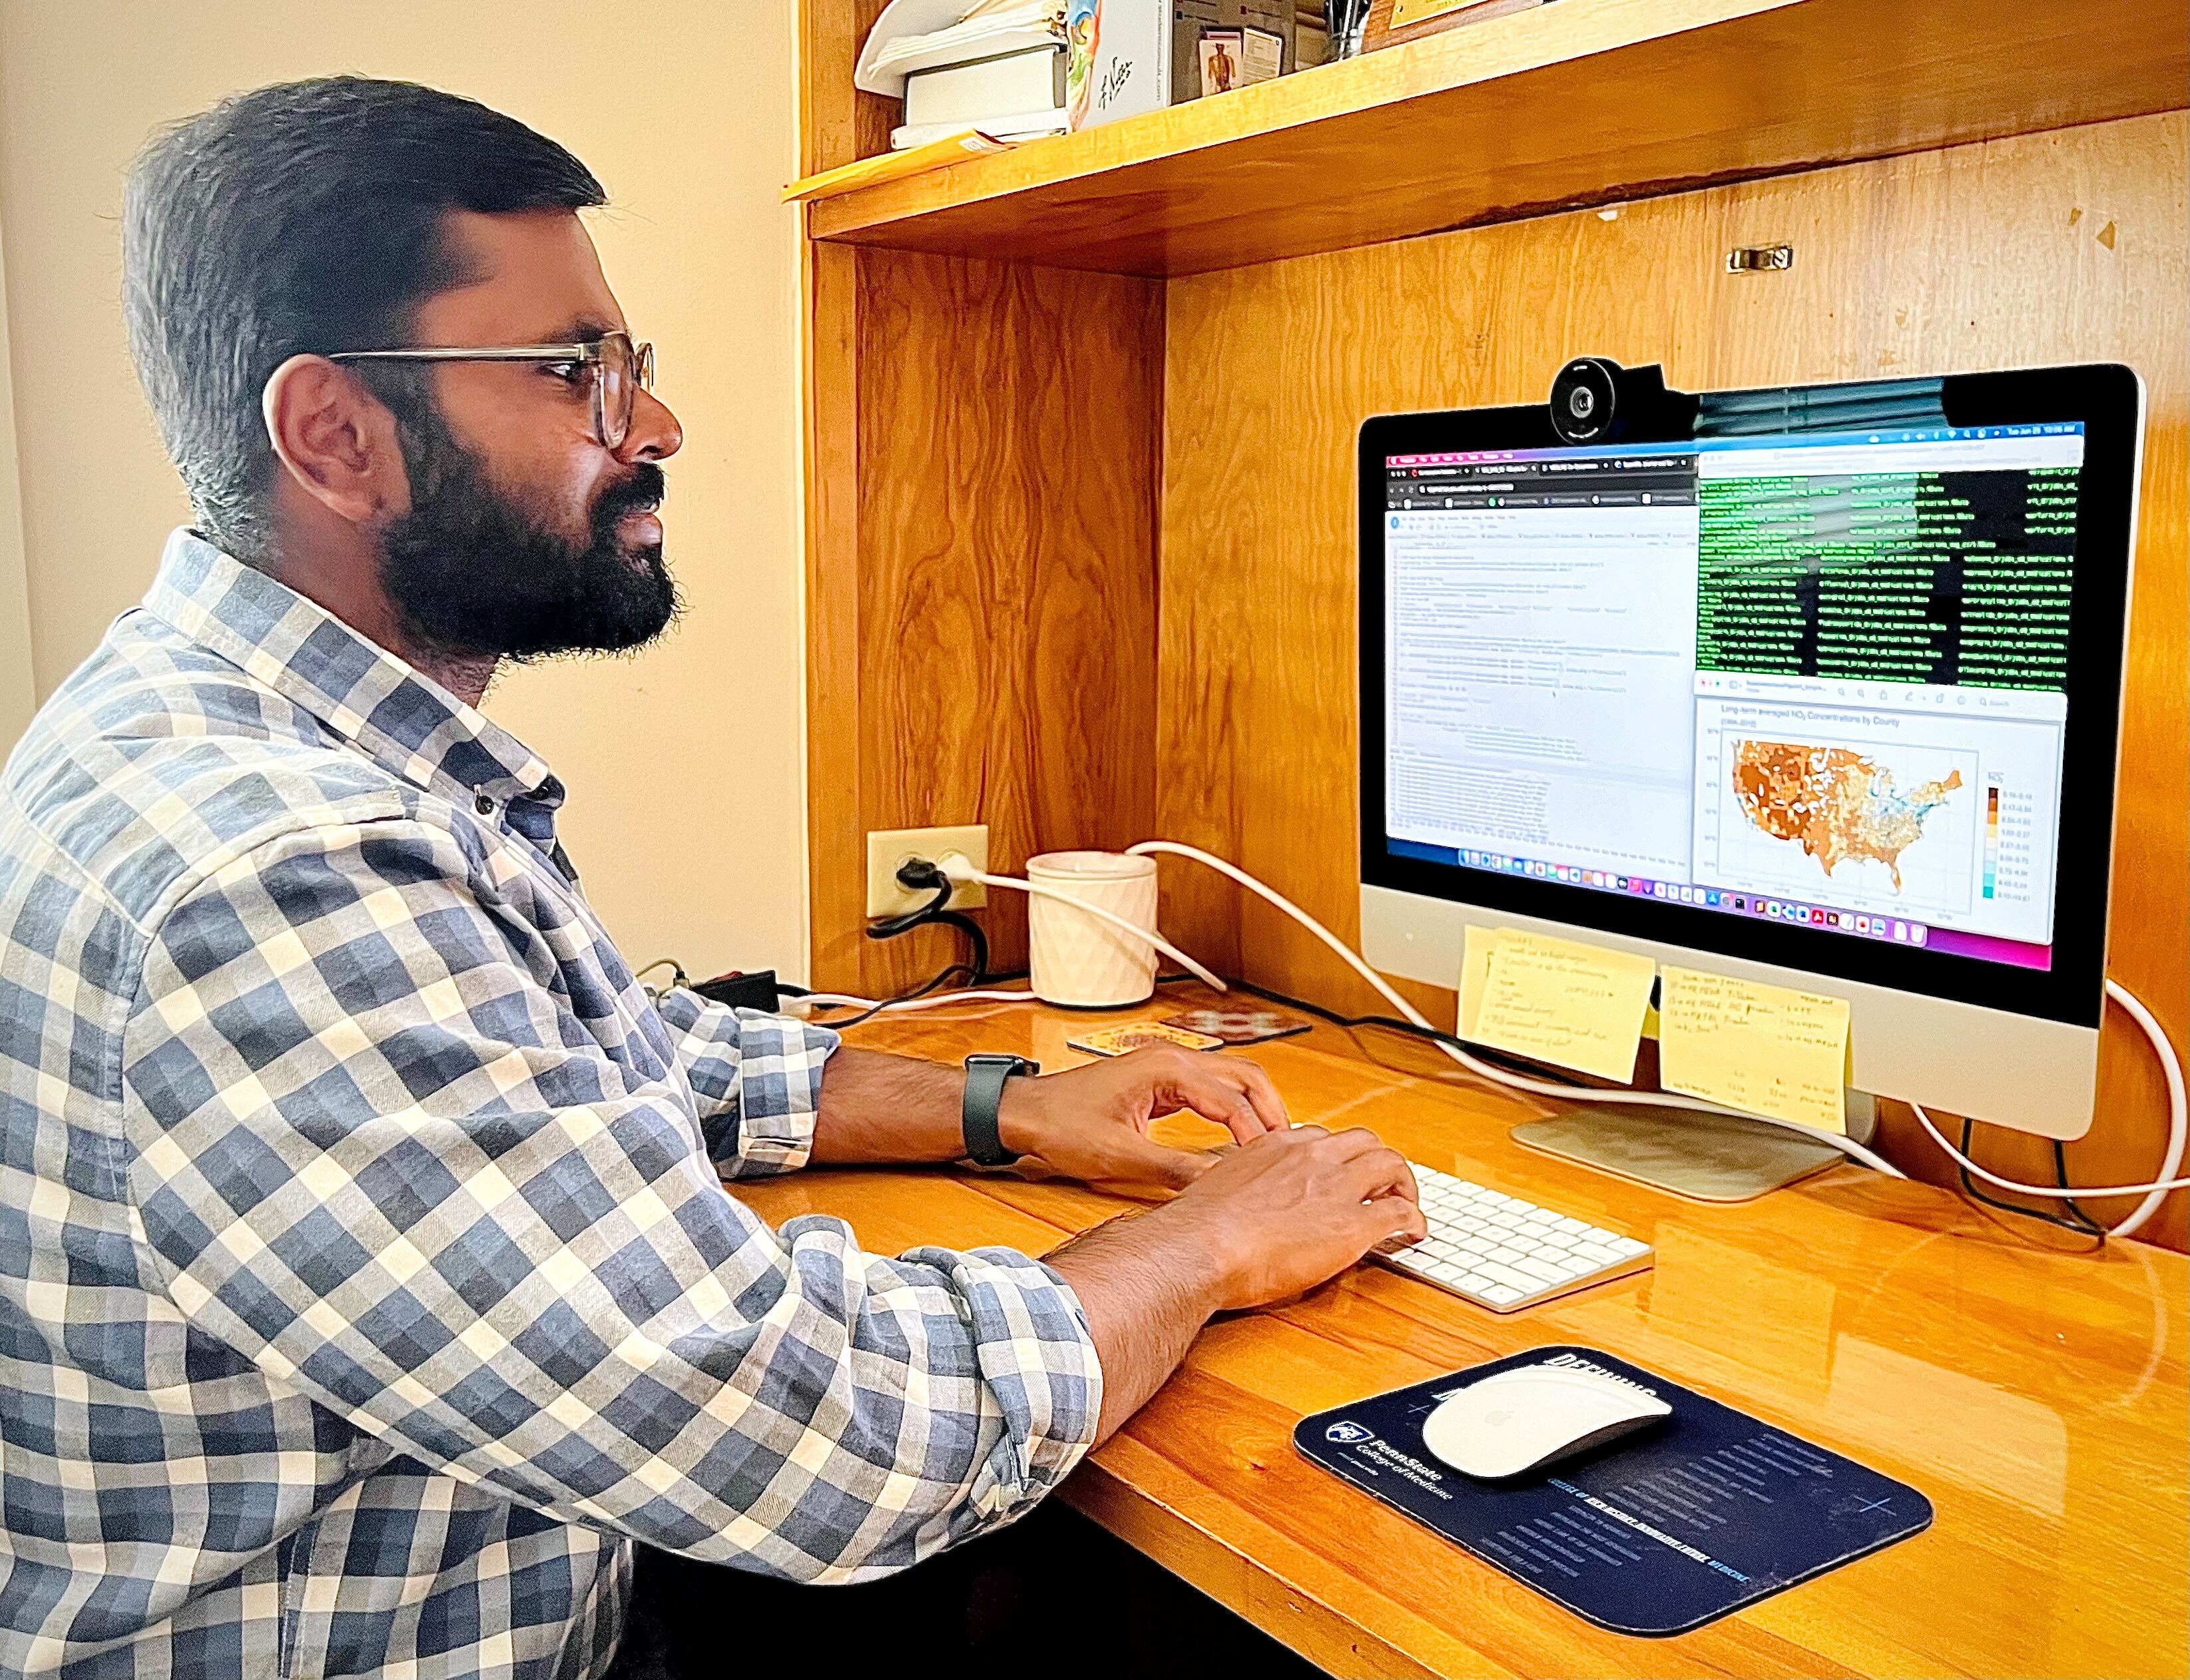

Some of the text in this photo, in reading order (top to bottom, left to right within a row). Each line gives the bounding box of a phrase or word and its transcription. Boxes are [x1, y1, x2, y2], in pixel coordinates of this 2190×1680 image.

[1721, 704, 1757, 715] Long-term
[1808, 711, 1860, 723] Concentrations
[1862, 716, 1870, 726] by
[1874, 716, 1900, 728] County
[1356, 1444, 1394, 1467] College
[1406, 1469, 1454, 1501] Medicine
[1368, 1439, 1443, 1482] PennState
